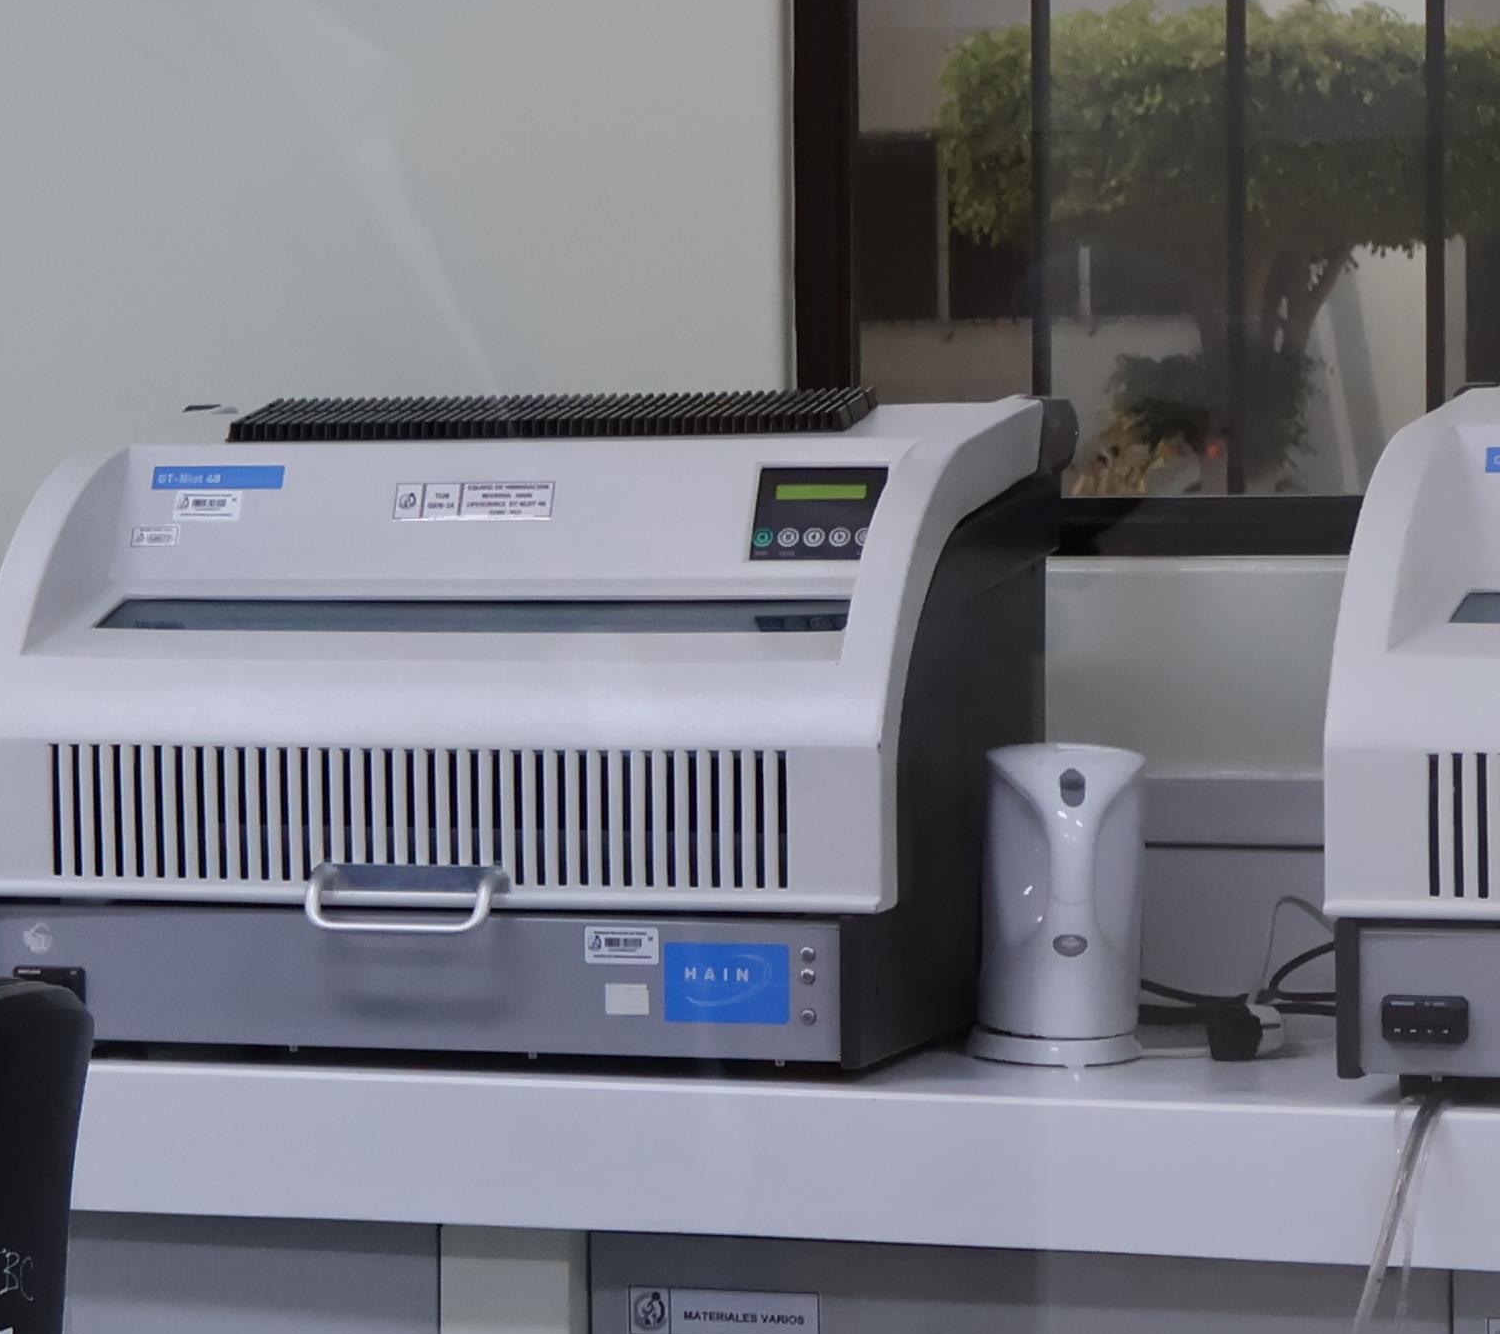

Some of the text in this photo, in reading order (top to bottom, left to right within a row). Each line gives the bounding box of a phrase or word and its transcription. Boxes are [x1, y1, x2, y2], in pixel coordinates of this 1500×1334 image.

[684, 967, 749, 982] HAIN
[683, 1310, 805, 1326] MATERIALES VARIOS
